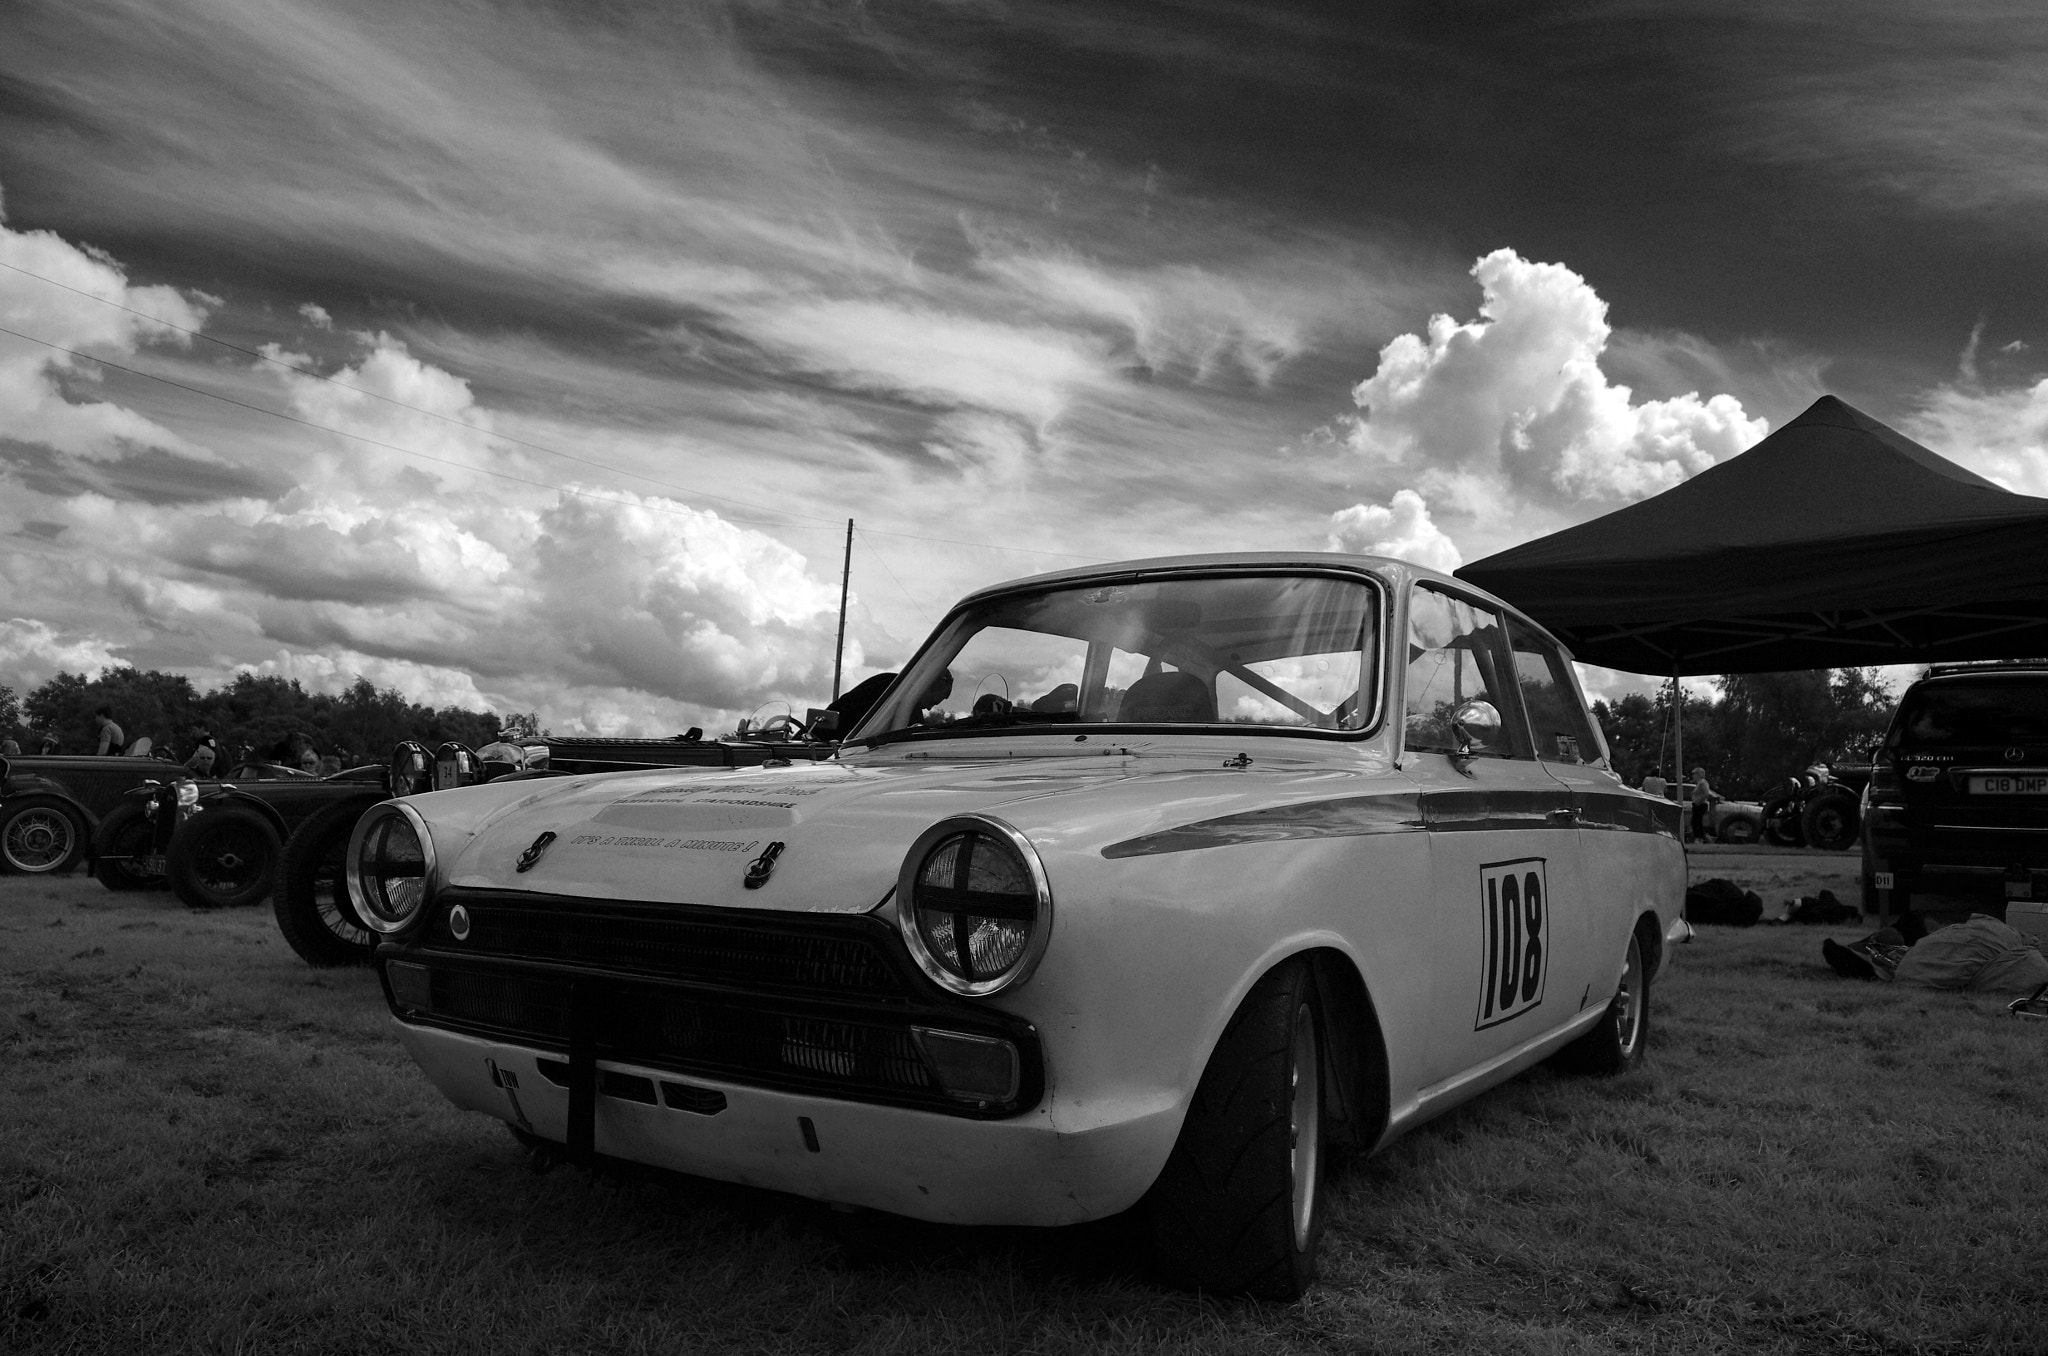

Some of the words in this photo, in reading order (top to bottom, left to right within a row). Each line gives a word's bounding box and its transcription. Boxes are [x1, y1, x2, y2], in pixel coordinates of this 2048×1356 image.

[2015, 779, 2047, 792] DMP
[600, 836, 615, 846] A
[614, 836, 665, 847] THRILL
[664, 838, 681, 848] A
[1483, 872, 1542, 1020] 108
